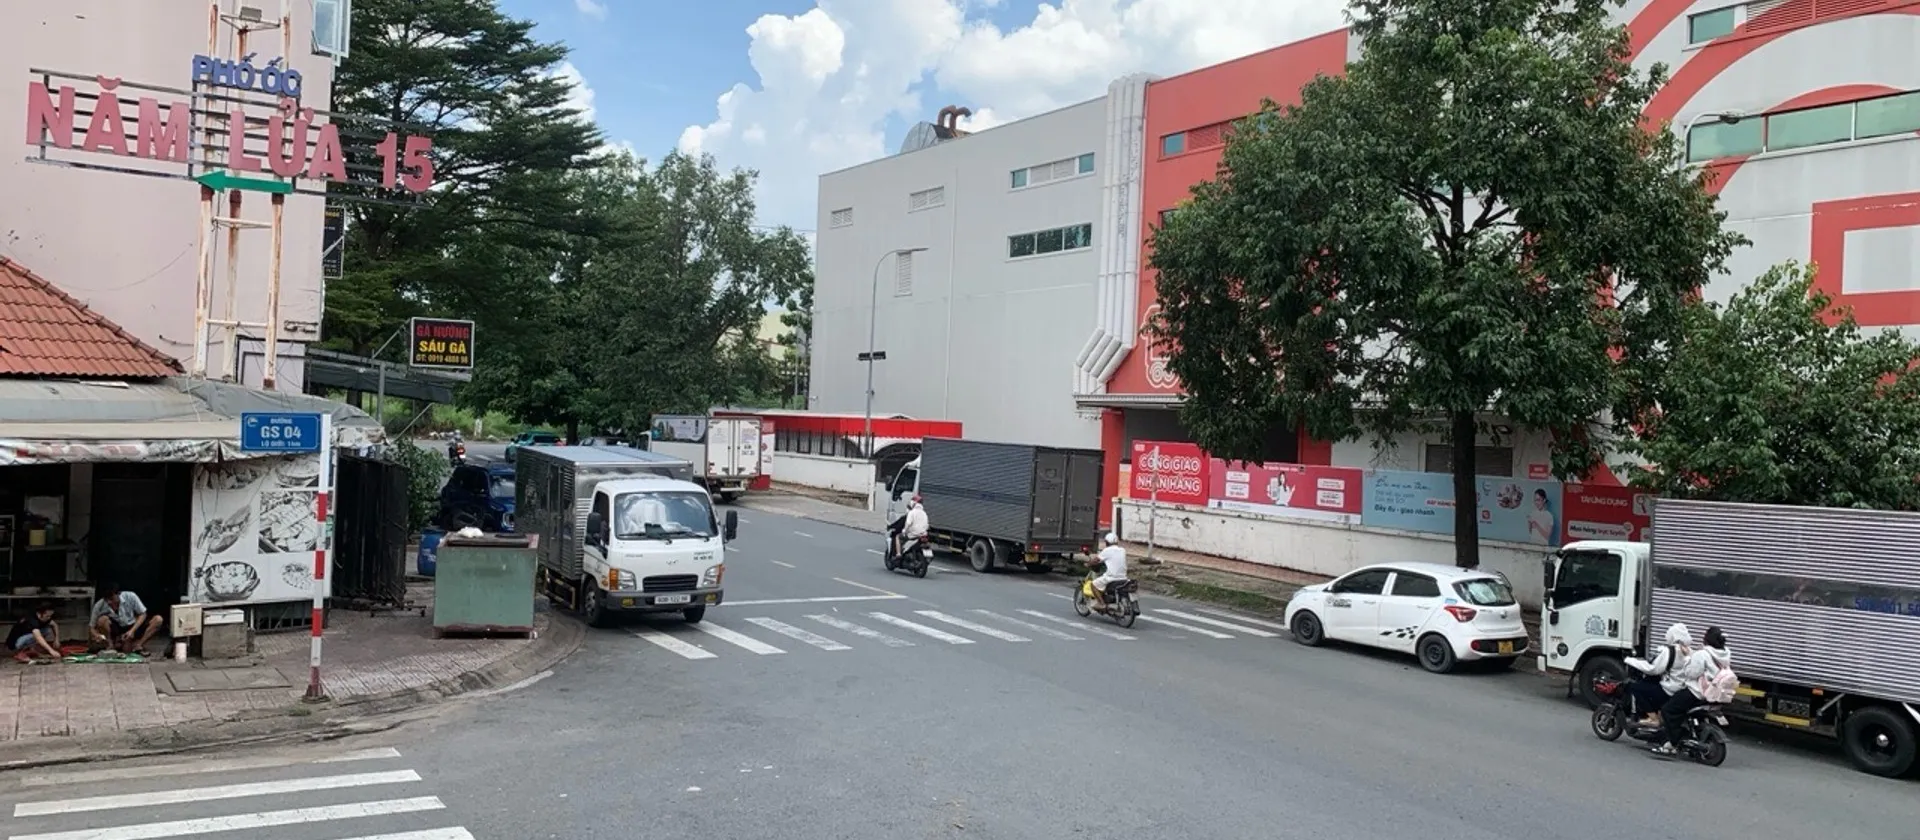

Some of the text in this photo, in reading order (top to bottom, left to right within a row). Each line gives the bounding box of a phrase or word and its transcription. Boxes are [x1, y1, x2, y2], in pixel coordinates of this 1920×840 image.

[192, 52, 302, 97] PHỐ ỐC
[26, 74, 434, 193] NĂM LỬA 15
[419, 338, 467, 354] SÁU GÀ
[261, 425, 302, 439] GS 04
[1172, 456, 1200, 472] GIAO
[1169, 474, 1201, 493] HÀNG
